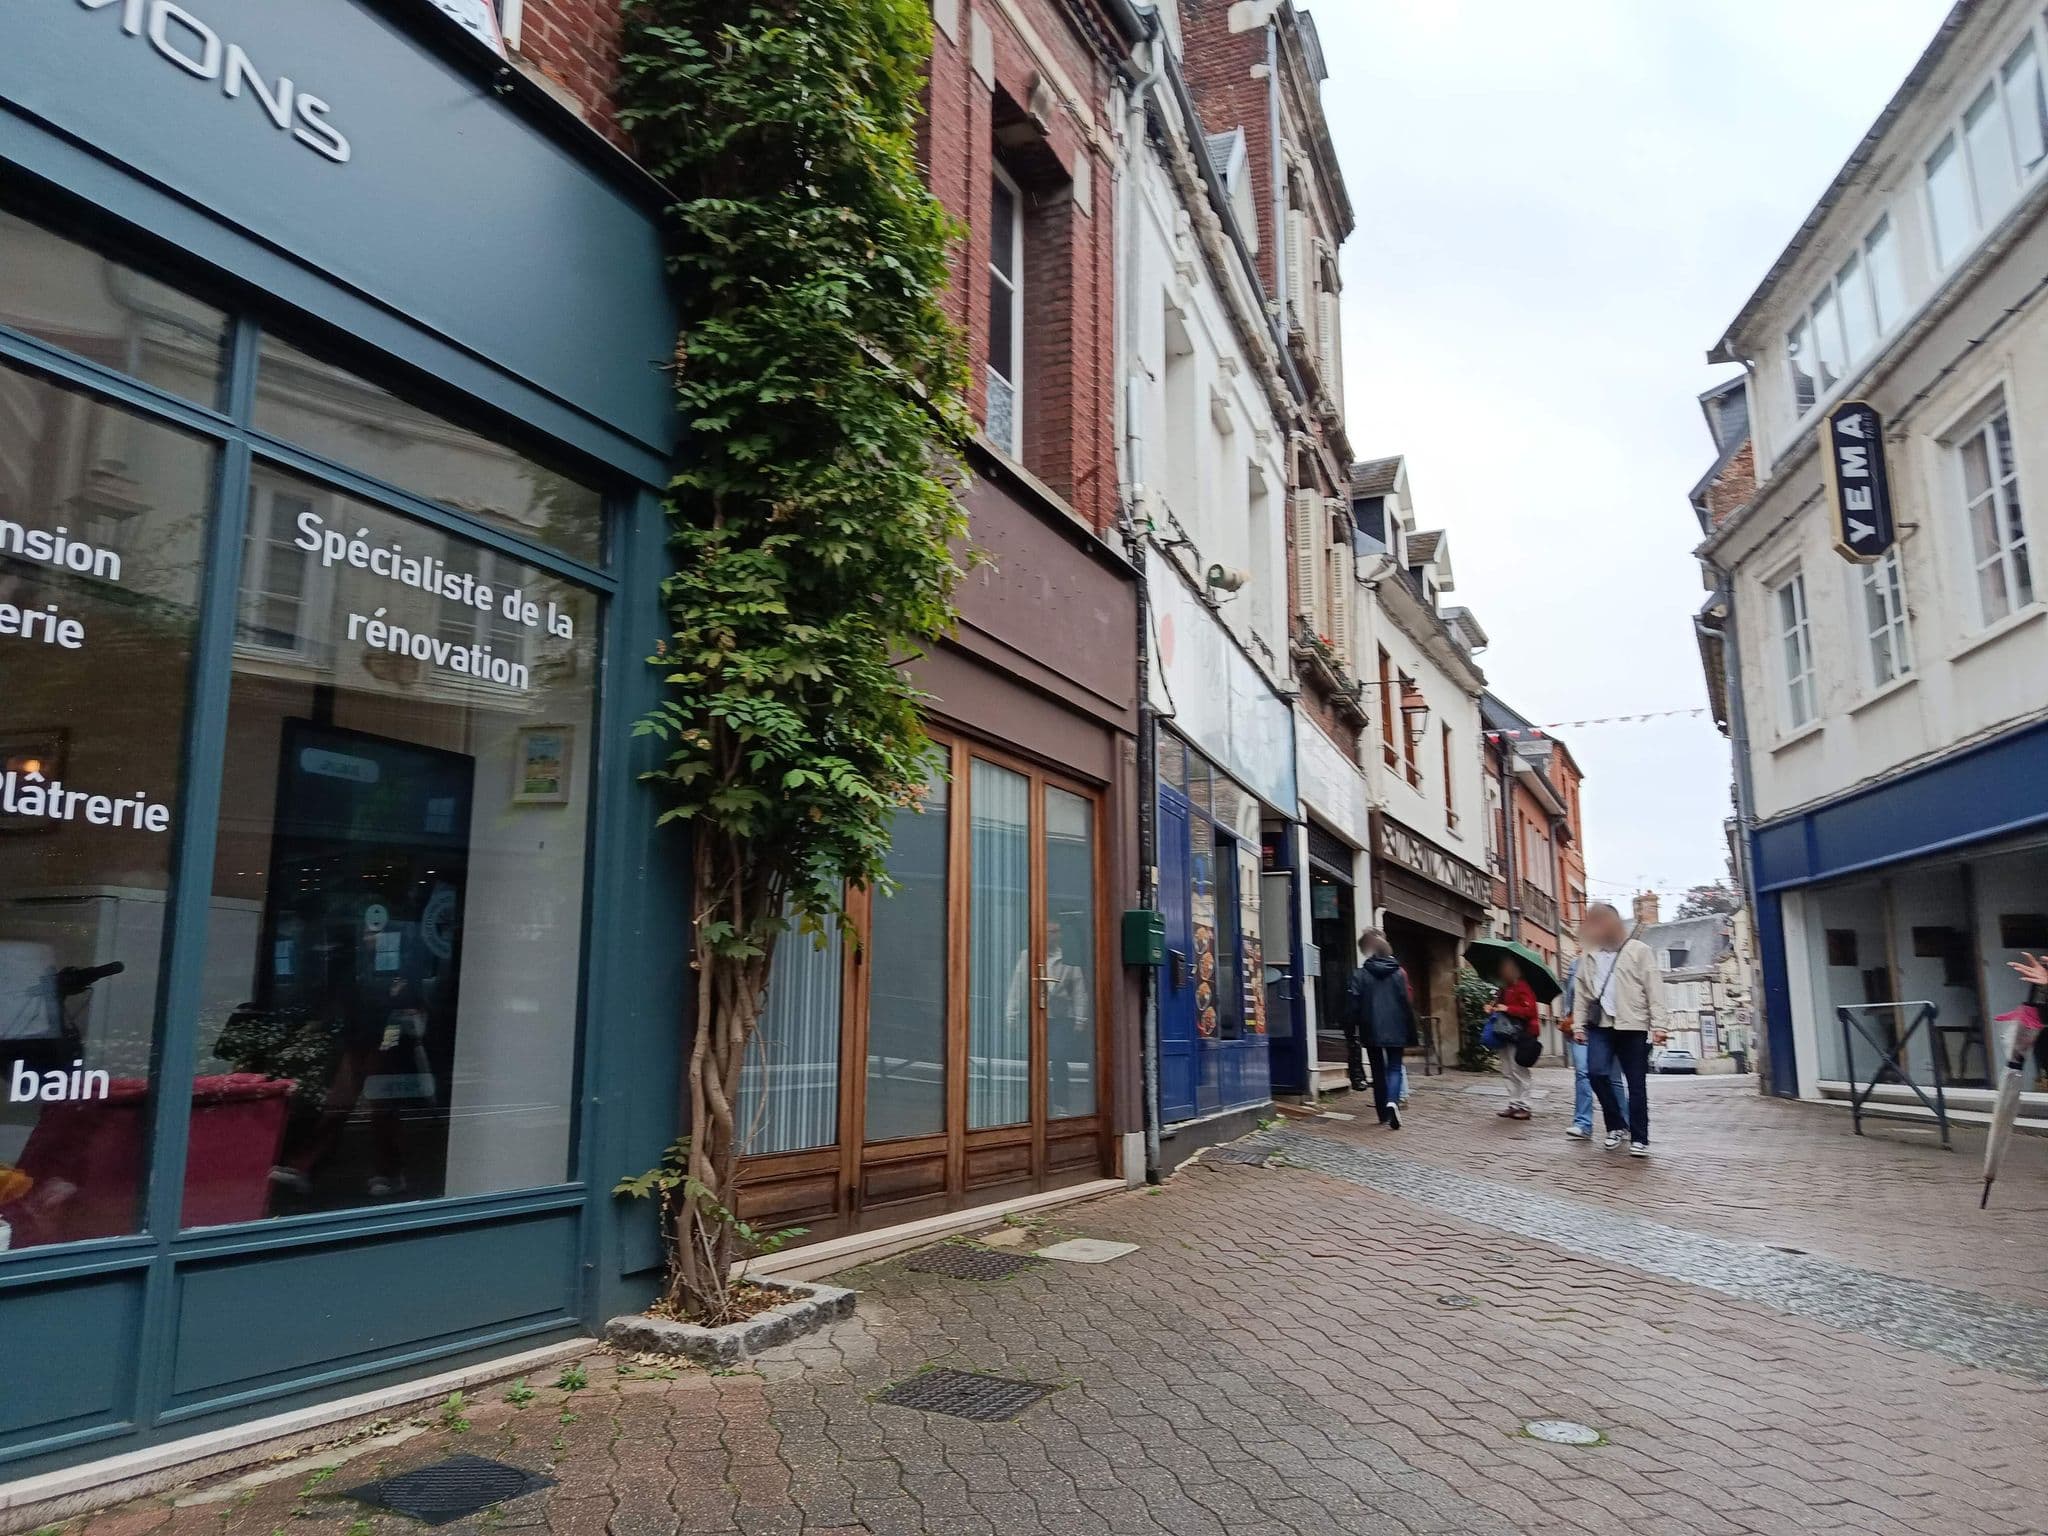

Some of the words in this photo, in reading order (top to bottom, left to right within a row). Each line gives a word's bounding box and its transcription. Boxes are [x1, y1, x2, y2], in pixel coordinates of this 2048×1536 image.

[1836, 413, 1877, 543] YEMA
[0, 519, 121, 581] nsion
[294, 511, 494, 611] Spécialiste
[502, 589, 540, 627] de
[548, 602, 573, 640] la
[0, 603, 85, 649] erie
[348, 607, 529, 690] rénovation
[0, 770, 170, 832] lâtrerie
[10, 1059, 110, 1102] bain
